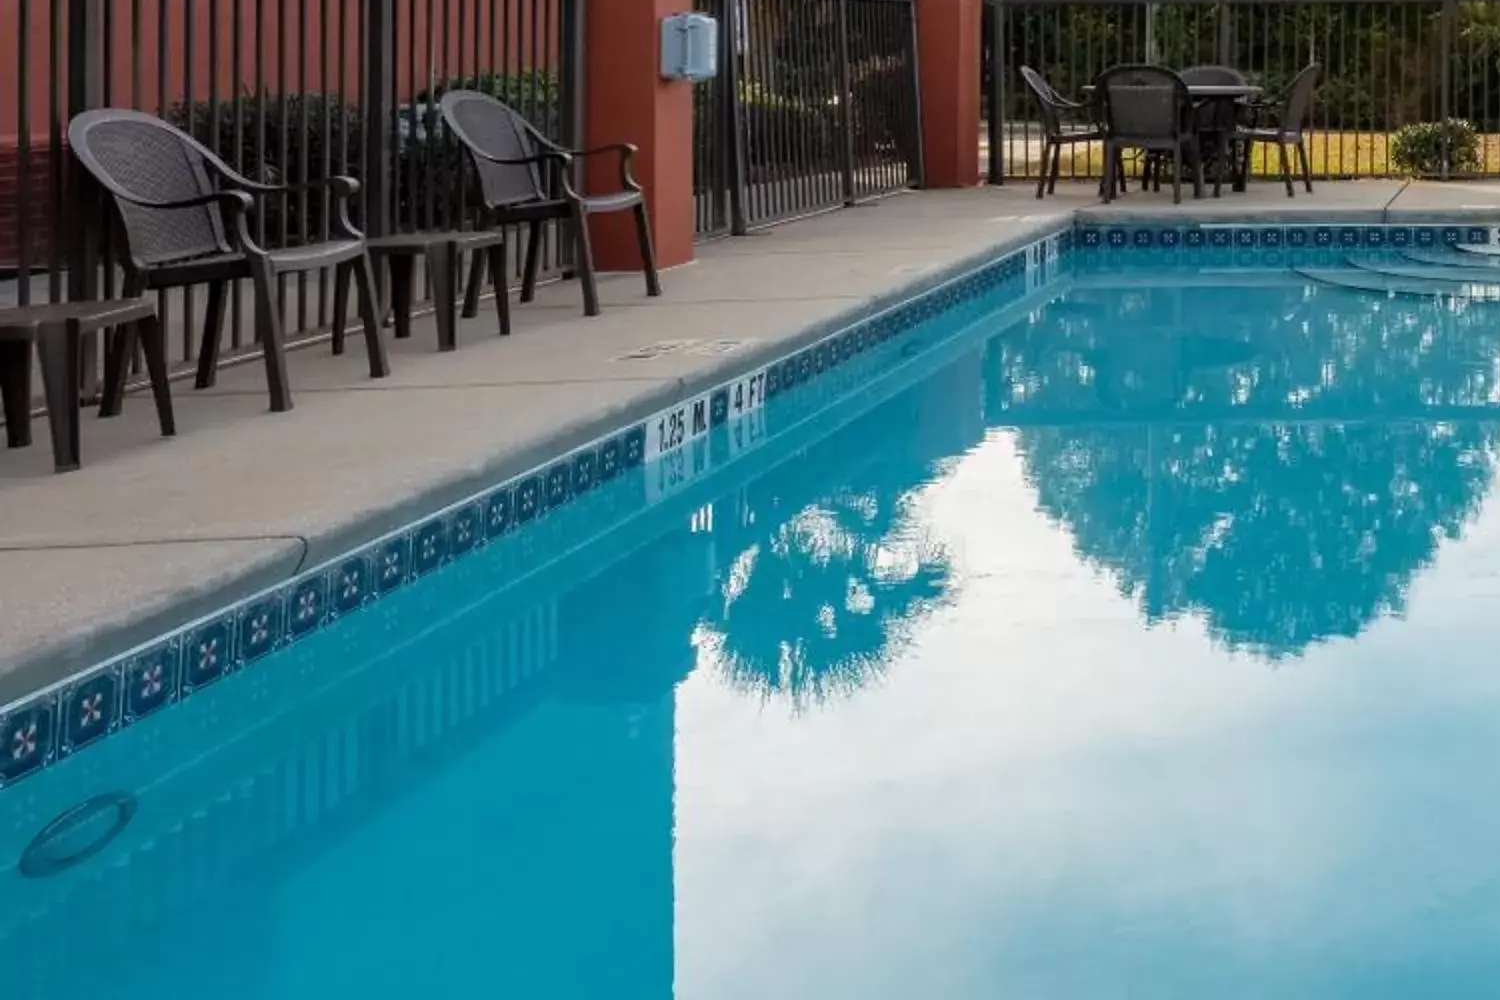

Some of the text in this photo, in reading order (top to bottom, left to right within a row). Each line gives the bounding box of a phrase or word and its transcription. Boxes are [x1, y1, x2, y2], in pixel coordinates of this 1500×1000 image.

[734, 373, 764, 413] 4 FT
[658, 410, 685, 452] 1.25
